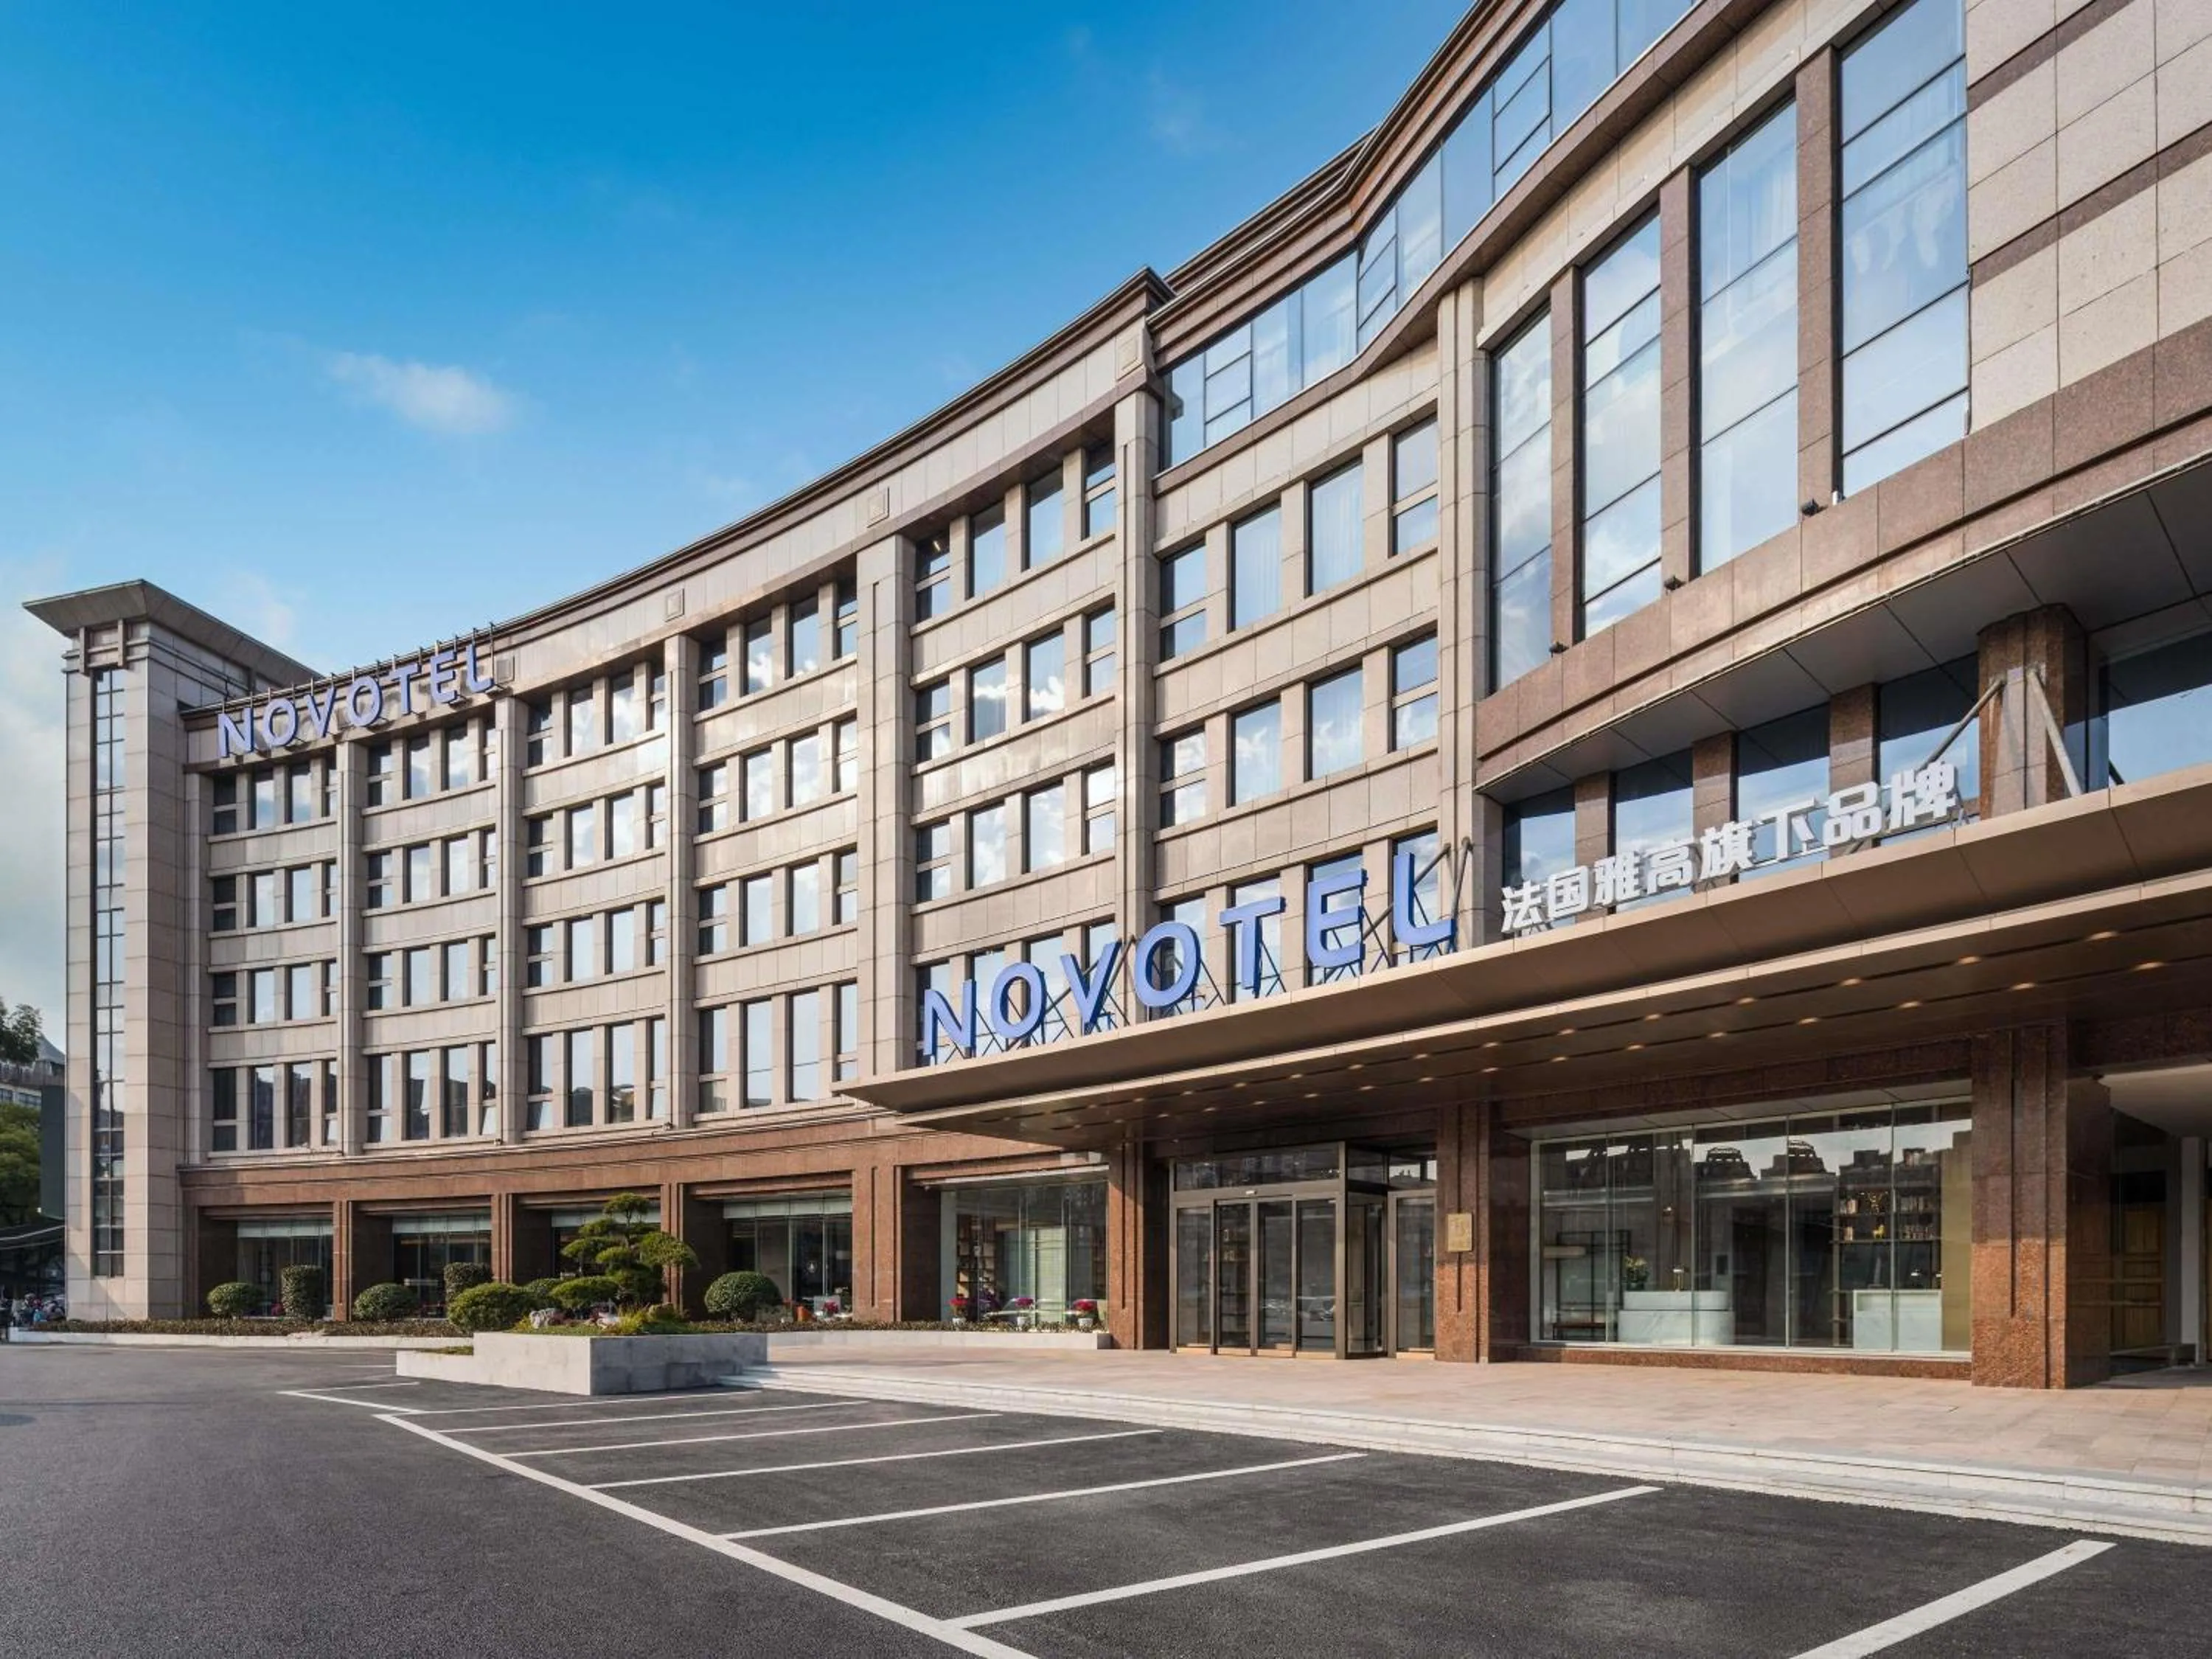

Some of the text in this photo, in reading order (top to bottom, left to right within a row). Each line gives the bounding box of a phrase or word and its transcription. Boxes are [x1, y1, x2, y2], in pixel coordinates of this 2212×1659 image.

[218, 644, 493, 759] NOVOTEL
[1500, 762, 1958, 932] 法国雅高旗下品牌
[923, 852, 1457, 1057] NOVOTEL
